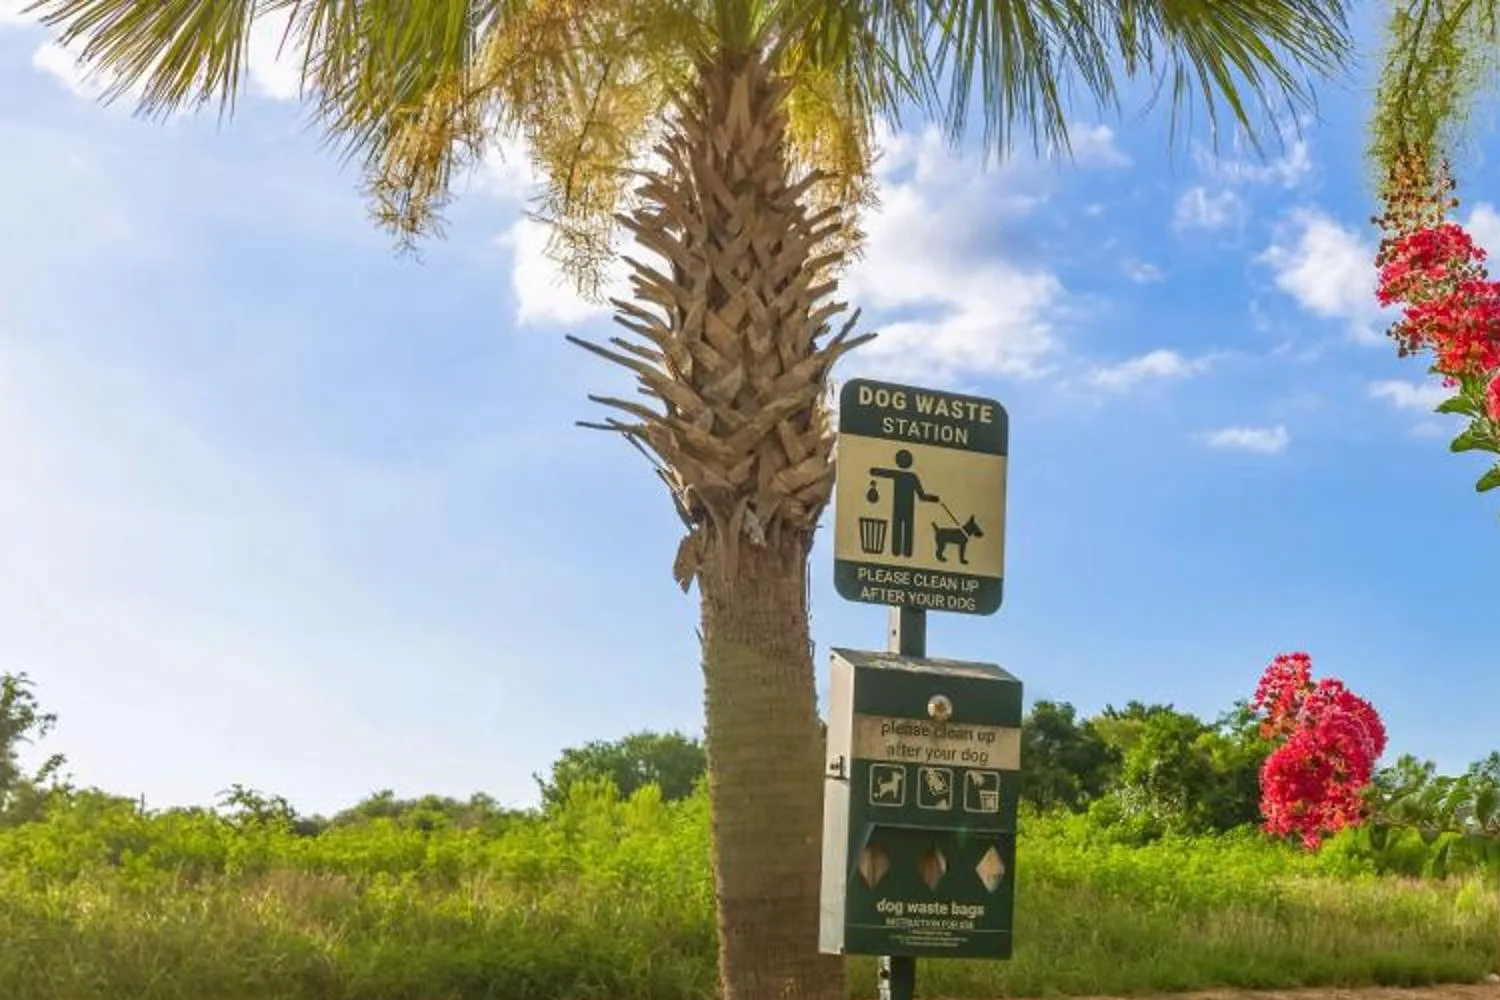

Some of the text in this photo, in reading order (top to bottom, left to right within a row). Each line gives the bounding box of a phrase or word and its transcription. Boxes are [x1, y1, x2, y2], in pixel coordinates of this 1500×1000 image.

[859, 385, 993, 424] DOG WASTE
[882, 417, 969, 445] STATION
[857, 568, 979, 593] PLEASE CLEAN UP
[860, 586, 976, 611] AFTER YOUR DOG
[881, 721, 996, 745] please clean up
[886, 742, 989, 765] after your dog
[877, 897, 985, 919] dog waste bags
